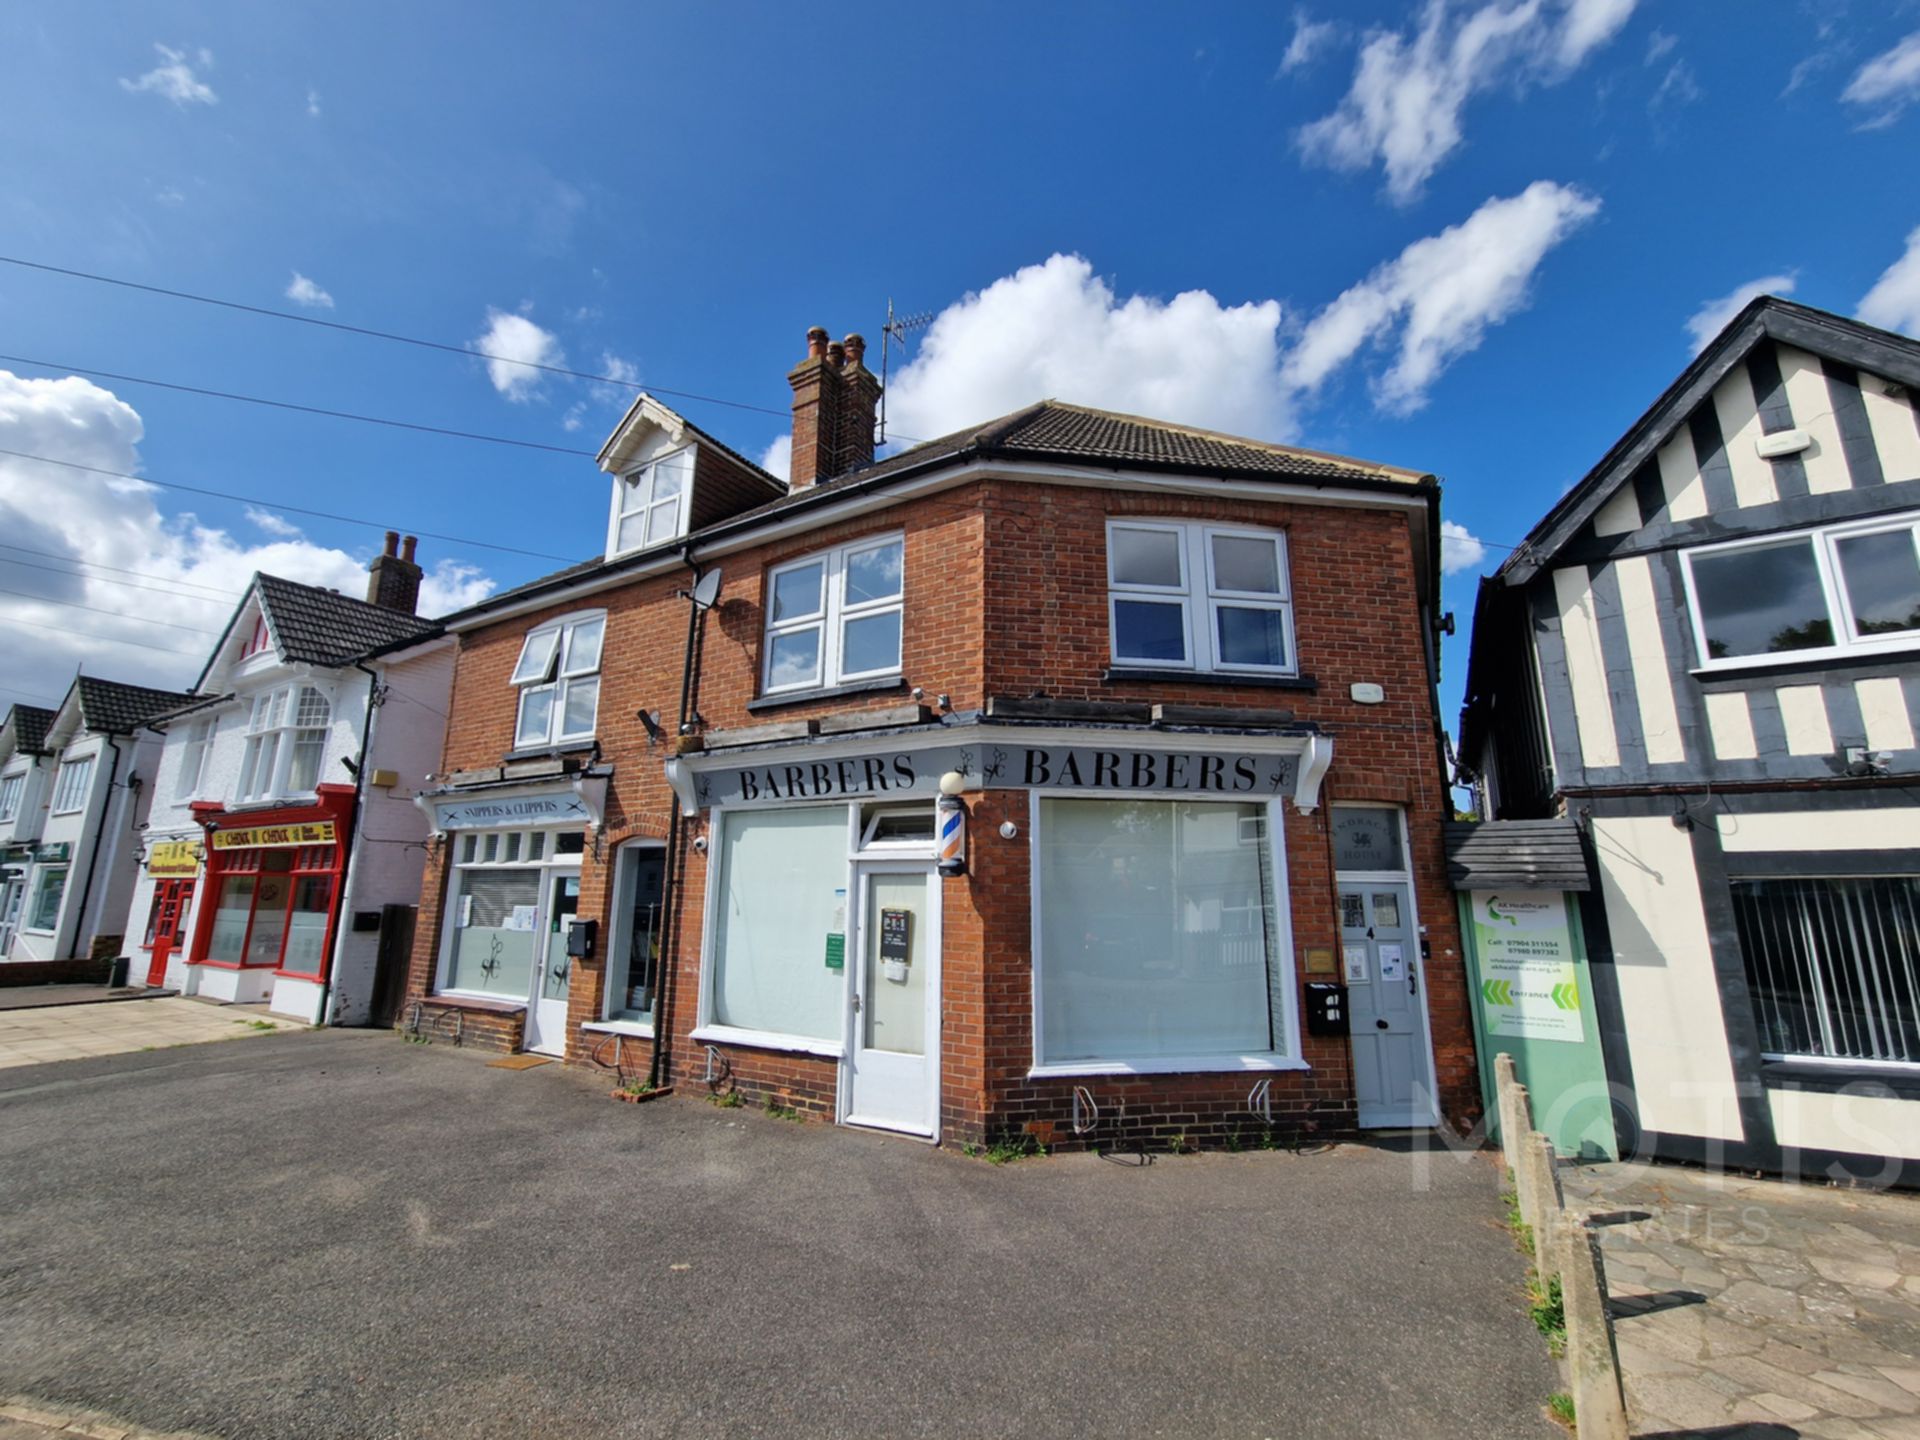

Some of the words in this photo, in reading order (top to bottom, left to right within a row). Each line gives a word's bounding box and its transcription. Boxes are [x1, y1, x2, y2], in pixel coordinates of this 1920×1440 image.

[1024, 748, 1258, 791] BARBERS
[740, 754, 916, 801] BARBERS
[464, 804, 504, 818] SNIPPERS
[505, 806, 513, 815] &
[514, 800, 558, 815] CLIPPERS
[1344, 850, 1381, 860] HOUSE
[1509, 902, 1549, 910] Healthcare
[1366, 926, 1375, 940] 4
[1509, 990, 1549, 999] Entrance
